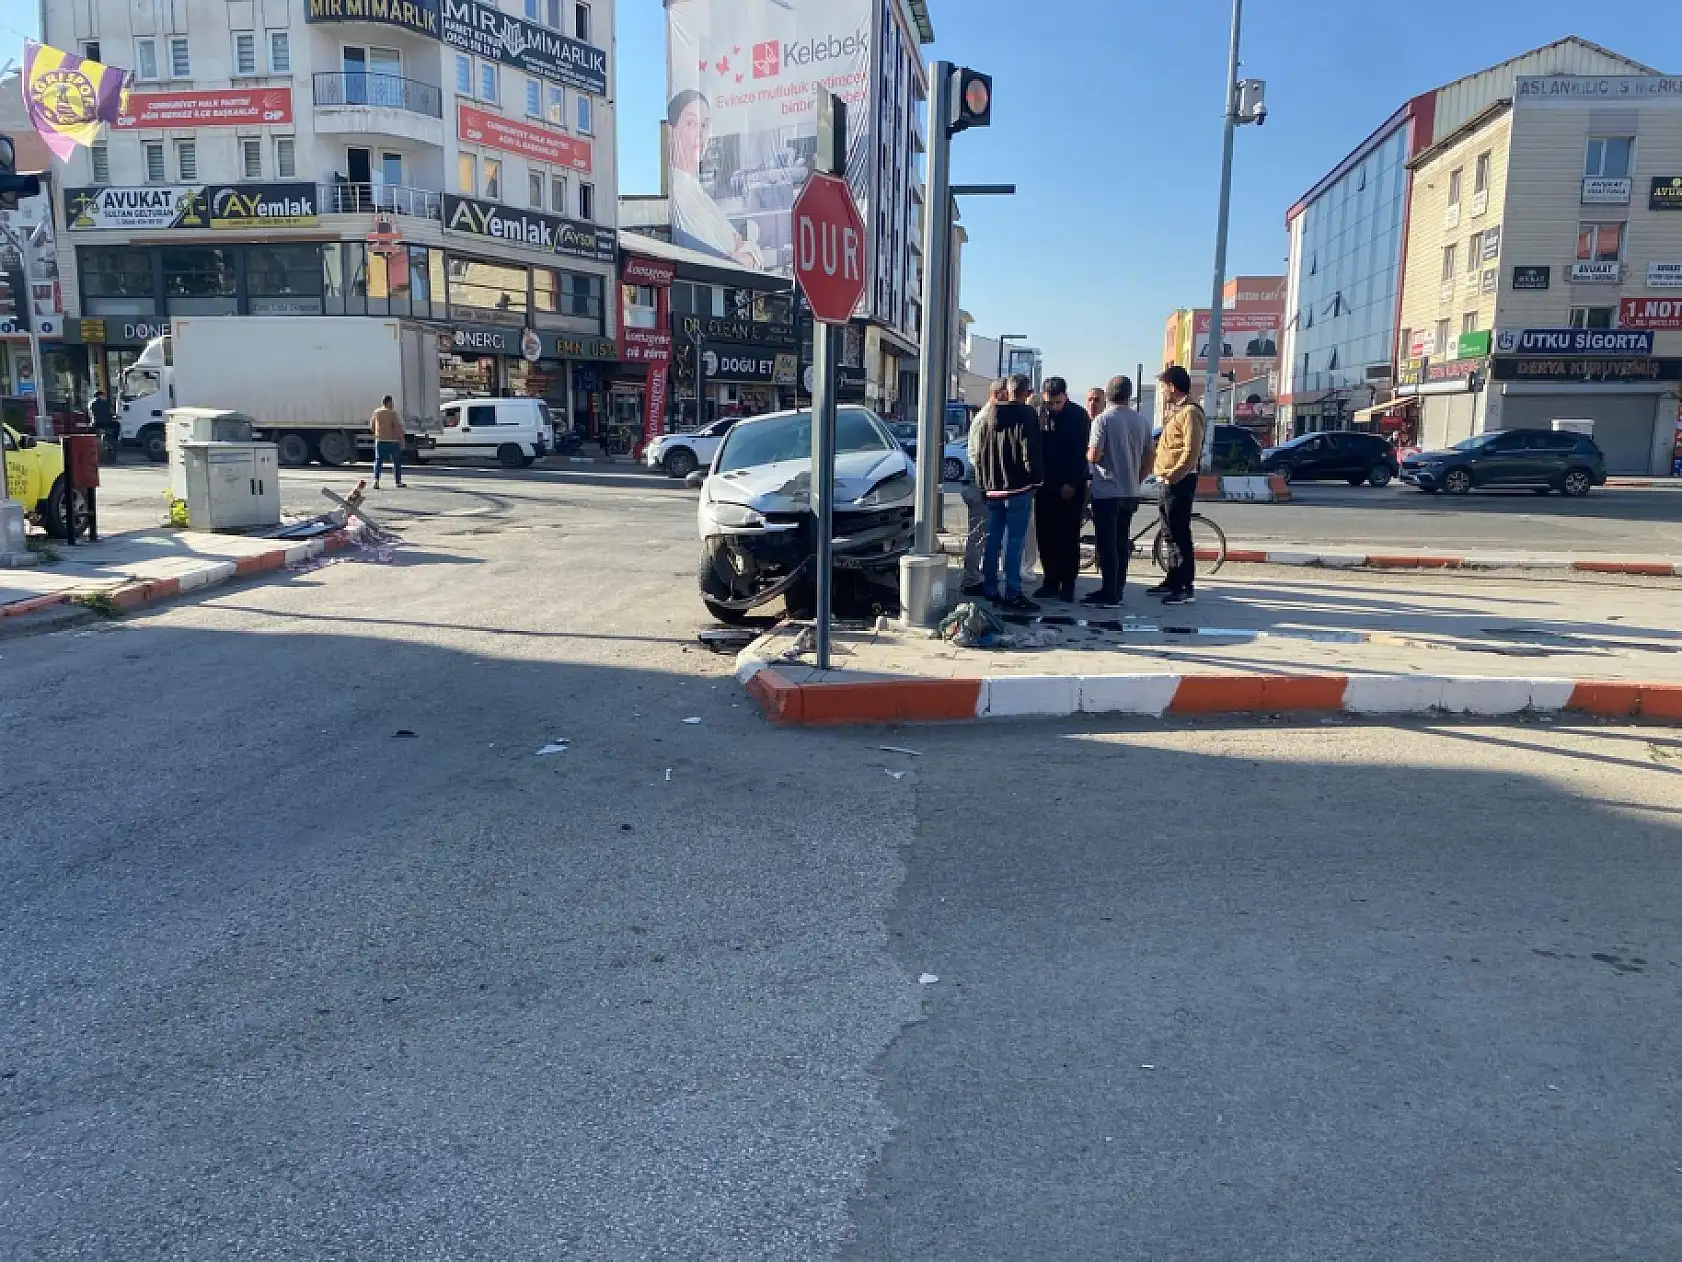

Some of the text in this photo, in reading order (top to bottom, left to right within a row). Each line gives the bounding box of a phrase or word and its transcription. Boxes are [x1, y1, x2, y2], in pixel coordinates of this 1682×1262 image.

[783, 29, 868, 68] Kelebek
[104, 190, 172, 209] AVUKAT
[449, 200, 552, 247] AYemlak
[800, 215, 860, 281] DUR
[1523, 330, 1648, 350] UTKU SİGORTA
[721, 356, 774, 375] DOĞU ET
